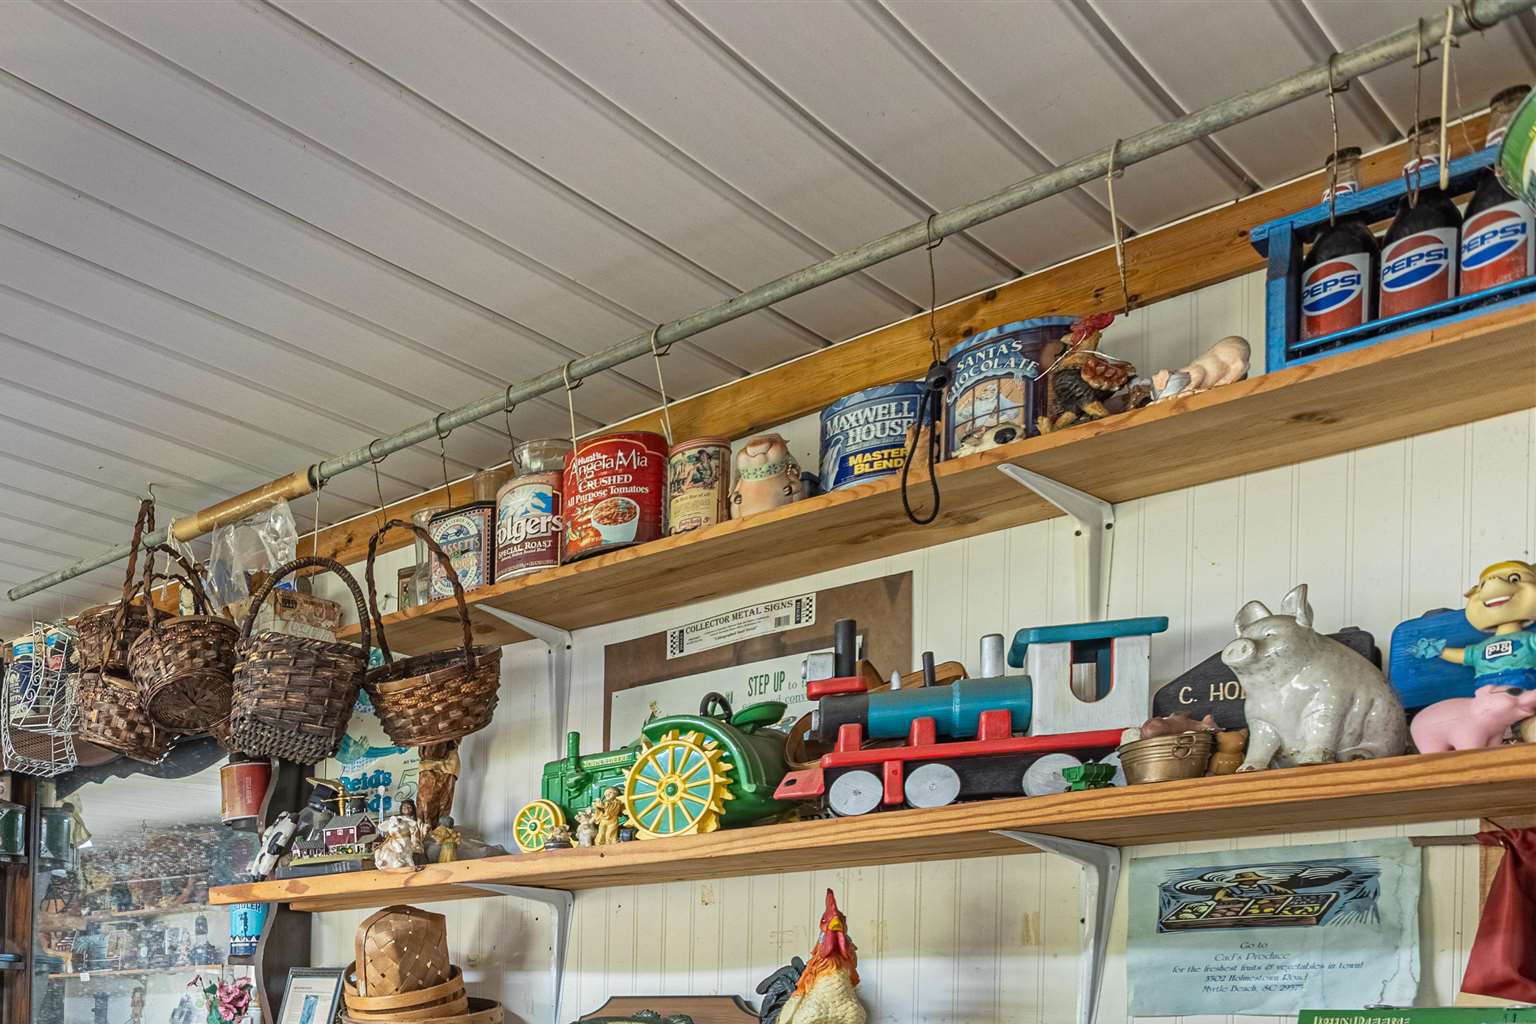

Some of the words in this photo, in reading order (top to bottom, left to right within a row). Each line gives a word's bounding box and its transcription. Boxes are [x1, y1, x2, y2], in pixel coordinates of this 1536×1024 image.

[1381, 247, 1448, 279] PEPSI
[1302, 273, 1361, 299] PEPSI
[956, 340, 1024, 373] SANTA'S
[946, 359, 1041, 404] CHOCOLATE
[825, 400, 914, 439] MAXWELL
[568, 456, 614, 487] Angela
[616, 449, 648, 470] Mia
[577, 451, 608, 464] Hunt's
[853, 457, 905, 476] BLEND
[576, 488, 608, 504] Purpose
[609, 484, 649, 496] Tomatoes
[578, 474, 633, 493] CRUSHED
[498, 543, 523, 560] SPECIAL
[525, 539, 553, 550] ROAST
[685, 614, 730, 635] COLLECTOR
[731, 607, 762, 621] METAL
[763, 600, 794, 613] SIGNS
[748, 673, 770, 698] STEP
[773, 670, 786, 692] UP
[787, 681, 798, 690] to
[1178, 686, 1198, 705] C.
[1239, 941, 1256, 949] Go
[1244, 952, 1290, 961] Produce
[1186, 964, 1201, 972] the
[1203, 963, 1243, 972] freshest
[1275, 962, 1327, 973] vegetables
